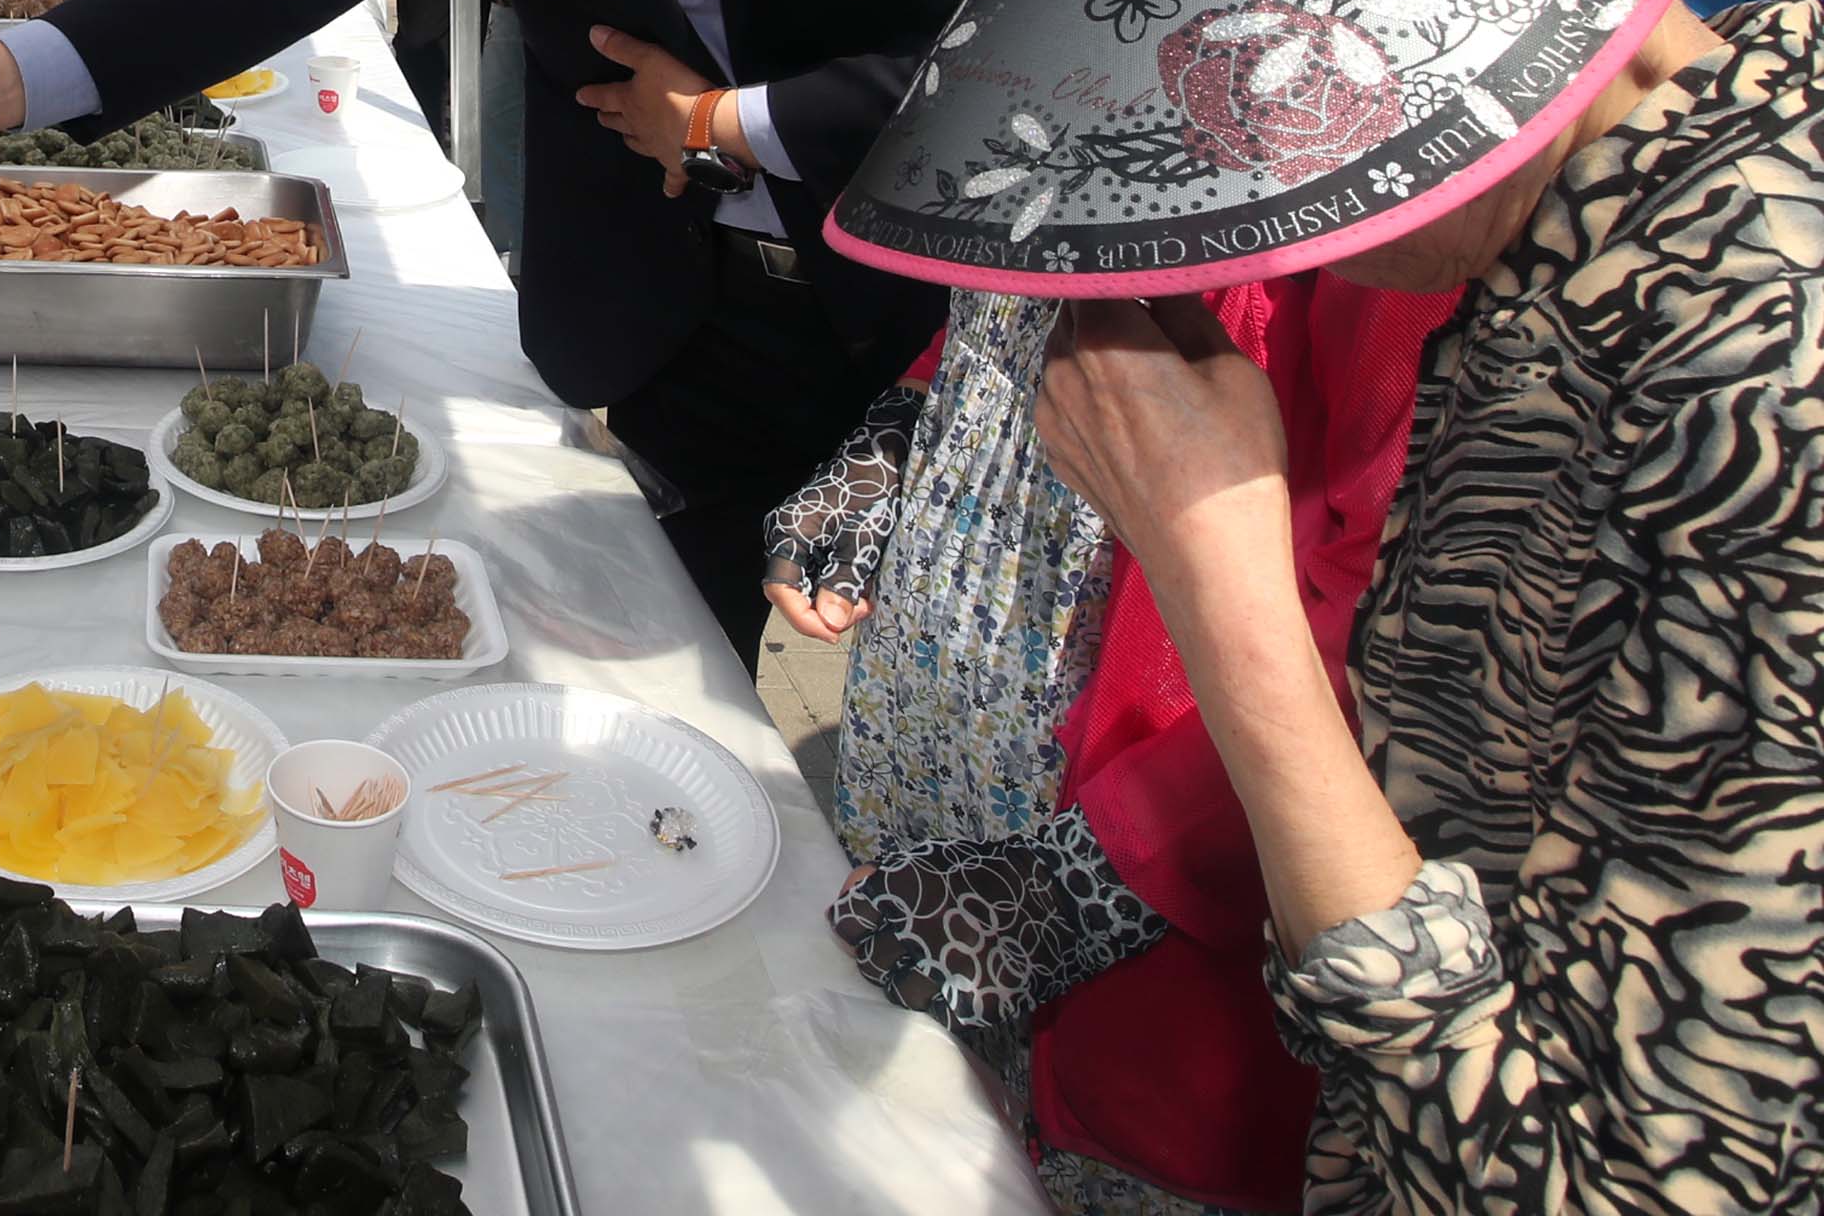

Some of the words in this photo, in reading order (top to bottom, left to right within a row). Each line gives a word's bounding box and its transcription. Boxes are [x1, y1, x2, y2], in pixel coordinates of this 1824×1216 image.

[1419, 115, 1489, 166] LUB
[1202, 187, 1369, 248] FASHION
[914, 232, 1032, 269] FASHION
[1097, 237, 1185, 270] CLUB
